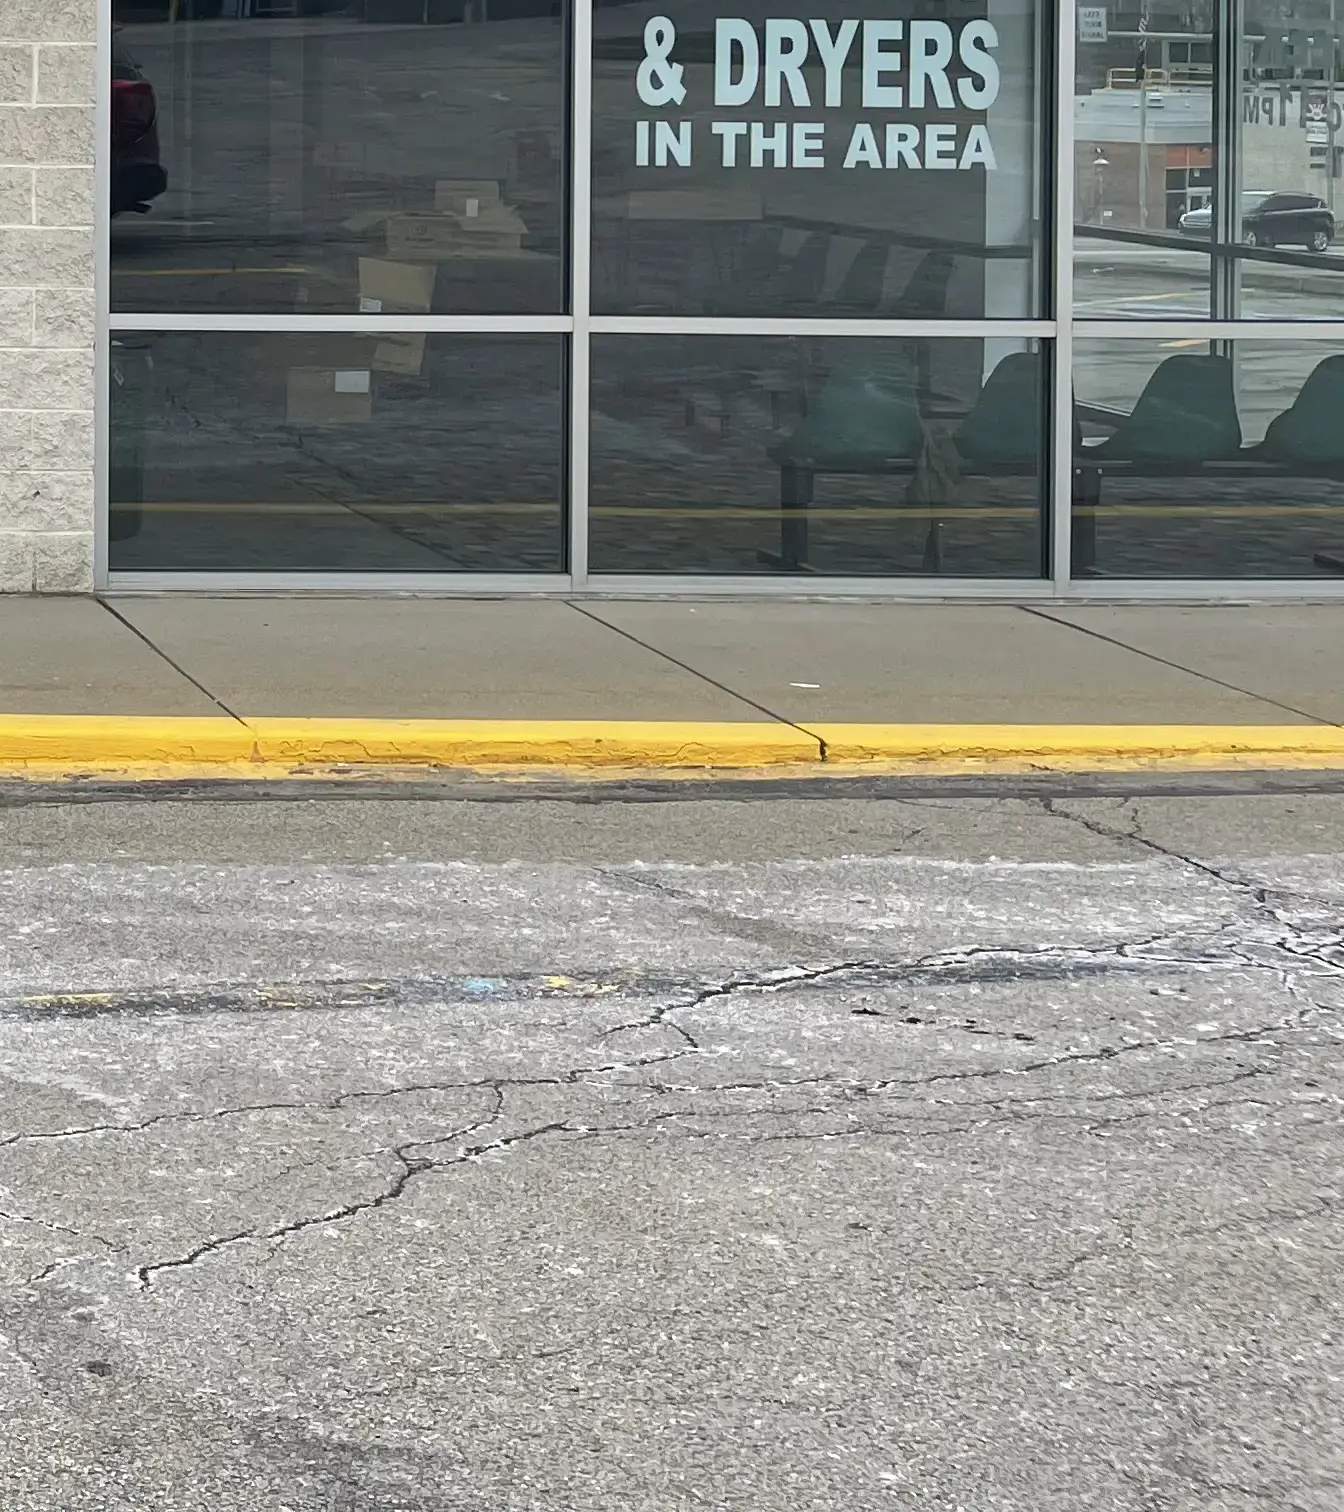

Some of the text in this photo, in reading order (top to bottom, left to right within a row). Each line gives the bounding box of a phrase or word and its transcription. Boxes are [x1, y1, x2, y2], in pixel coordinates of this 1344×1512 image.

[635, 16, 1000, 110] & DRYERS
[635, 120, 997, 170] IN THE AREA
